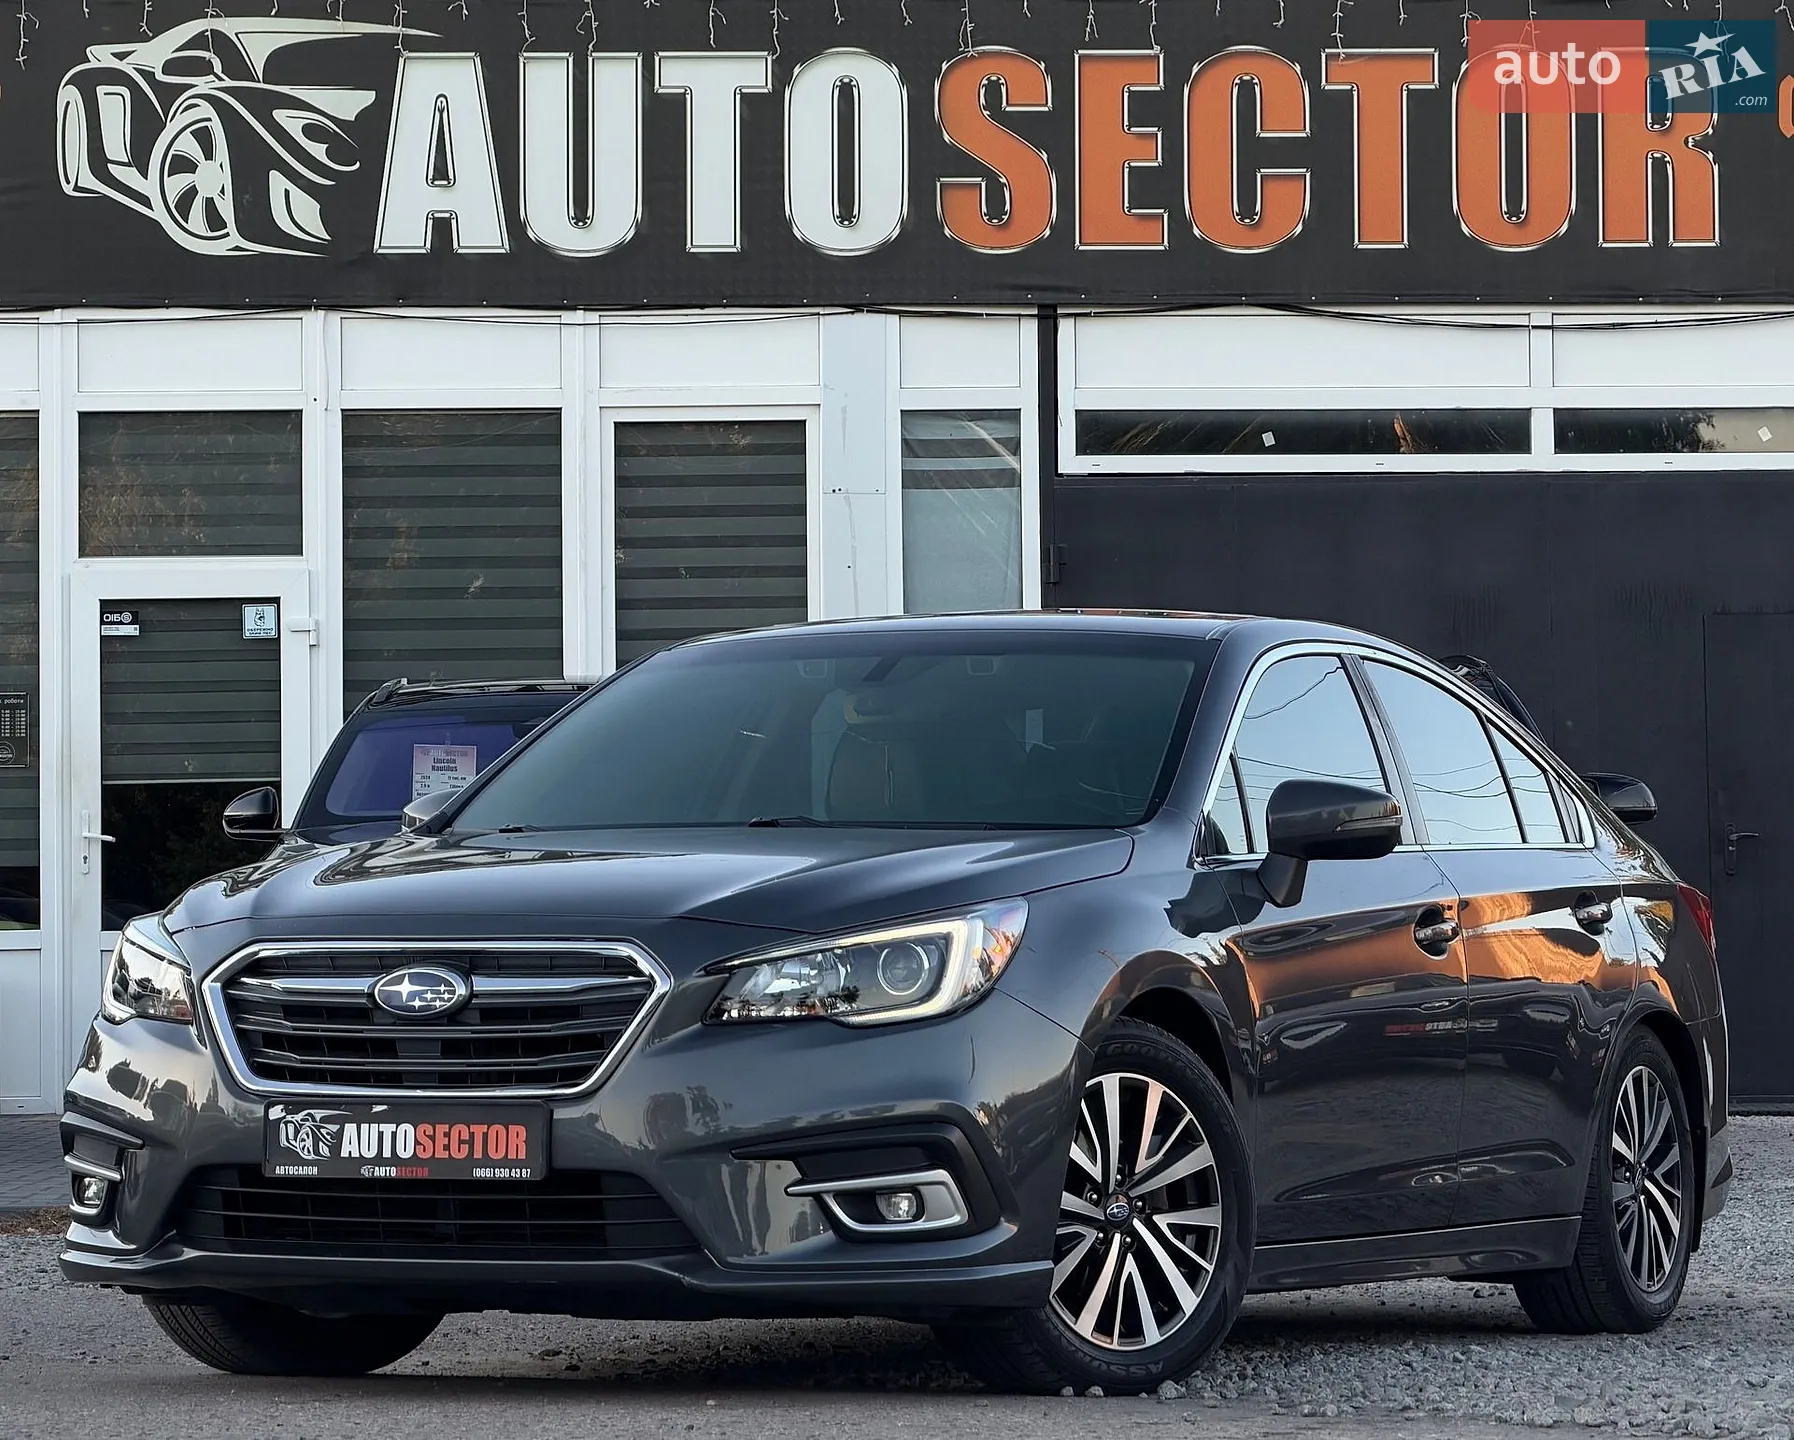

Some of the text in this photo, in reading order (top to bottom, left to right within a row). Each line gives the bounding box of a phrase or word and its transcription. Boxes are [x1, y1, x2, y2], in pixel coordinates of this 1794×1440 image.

[431, 764, 458, 772] Nautilus
[340, 1123, 527, 1160] AUTOSECTOR
[374, 1166, 429, 1177] AUTOSECTOR
[472, 1167, 531, 1178] (066) 930 43 87
